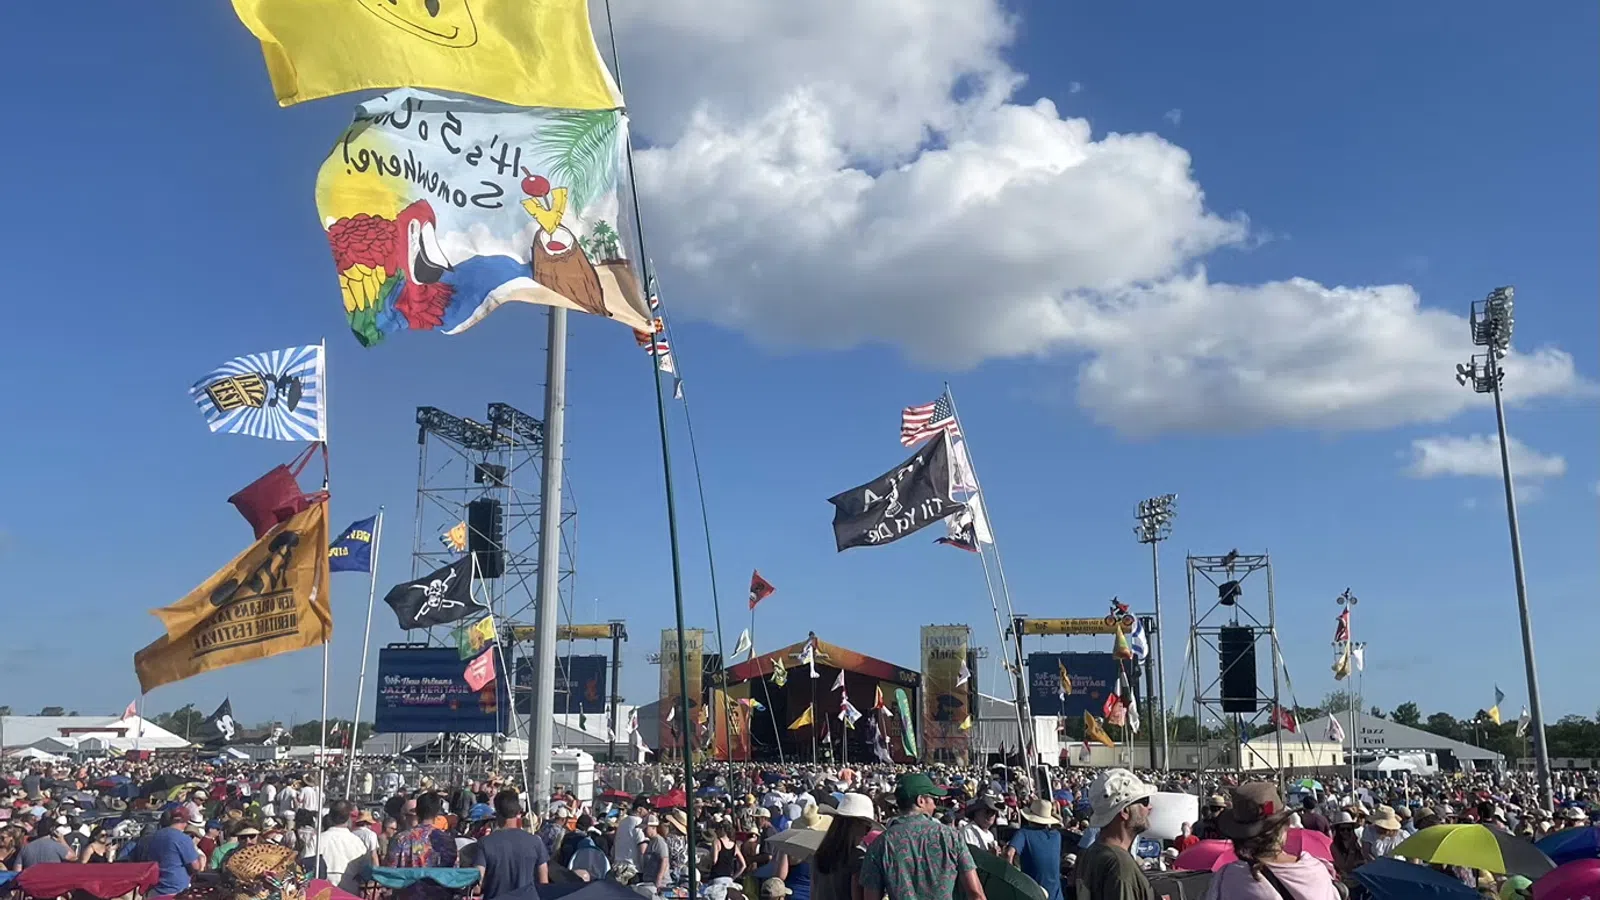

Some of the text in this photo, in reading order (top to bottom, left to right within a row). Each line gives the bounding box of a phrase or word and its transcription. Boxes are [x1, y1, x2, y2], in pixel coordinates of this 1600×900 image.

[930, 649, 956, 660] STAGE
[400, 677, 453, 686] New Orleans
[380, 685, 407, 694] JAZZ
[420, 685, 469, 694] HERITAGE
[402, 693, 446, 704] Festival
[1360, 727, 1384, 735] Jazz
[1360, 736, 1385, 744] Tent
